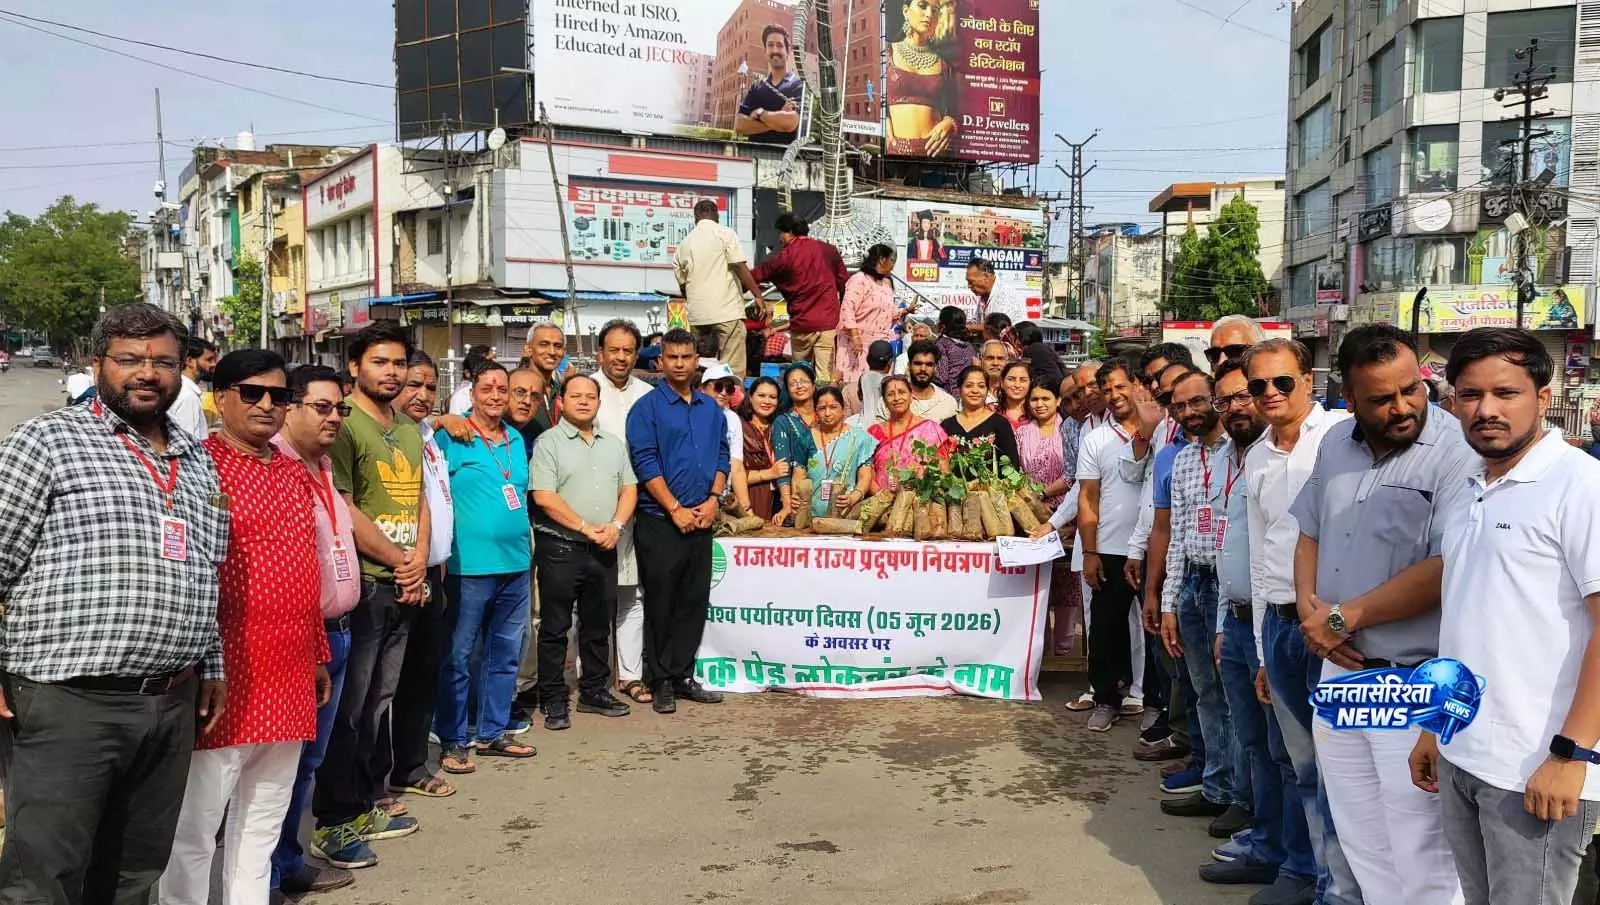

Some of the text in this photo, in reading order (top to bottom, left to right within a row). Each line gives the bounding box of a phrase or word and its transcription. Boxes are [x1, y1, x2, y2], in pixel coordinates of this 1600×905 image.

[623, 5, 636, 17] at
[641, 3, 680, 23] ISRO.
[555, 13, 687, 44] Hired by Amazon.
[960, 15, 1035, 37] ज्वेलरी के लिए
[555, 34, 625, 57] Educated
[629, 46, 642, 59] at
[974, 37, 1021, 53] वन स्टॉप
[968, 52, 1025, 72] डेस्टिनेशन
[990, 101, 1004, 113] DP
[963, 115, 1030, 131] D. P. Jewellers
[669, 190, 720, 209] स्टी
[974, 249, 1025, 263] SANGAM
[991, 261, 1025, 270] ERSITY
[911, 267, 937, 278] OPEN
[941, 294, 979, 306] DIAMON
[734, 545, 811, 568] राजस्थान
[814, 548, 857, 569] राज्य
[859, 549, 918, 579] प्रदूषण
[740, 602, 813, 627] पर्यावरण
[816, 604, 862, 628] दिवस
[867, 606, 900, 634] (05
[905, 613, 937, 637] जून
[941, 609, 1001, 634] 2026)
[804, 633, 892, 650] के अवसर पर
[954, 663, 1014, 698] नाम
